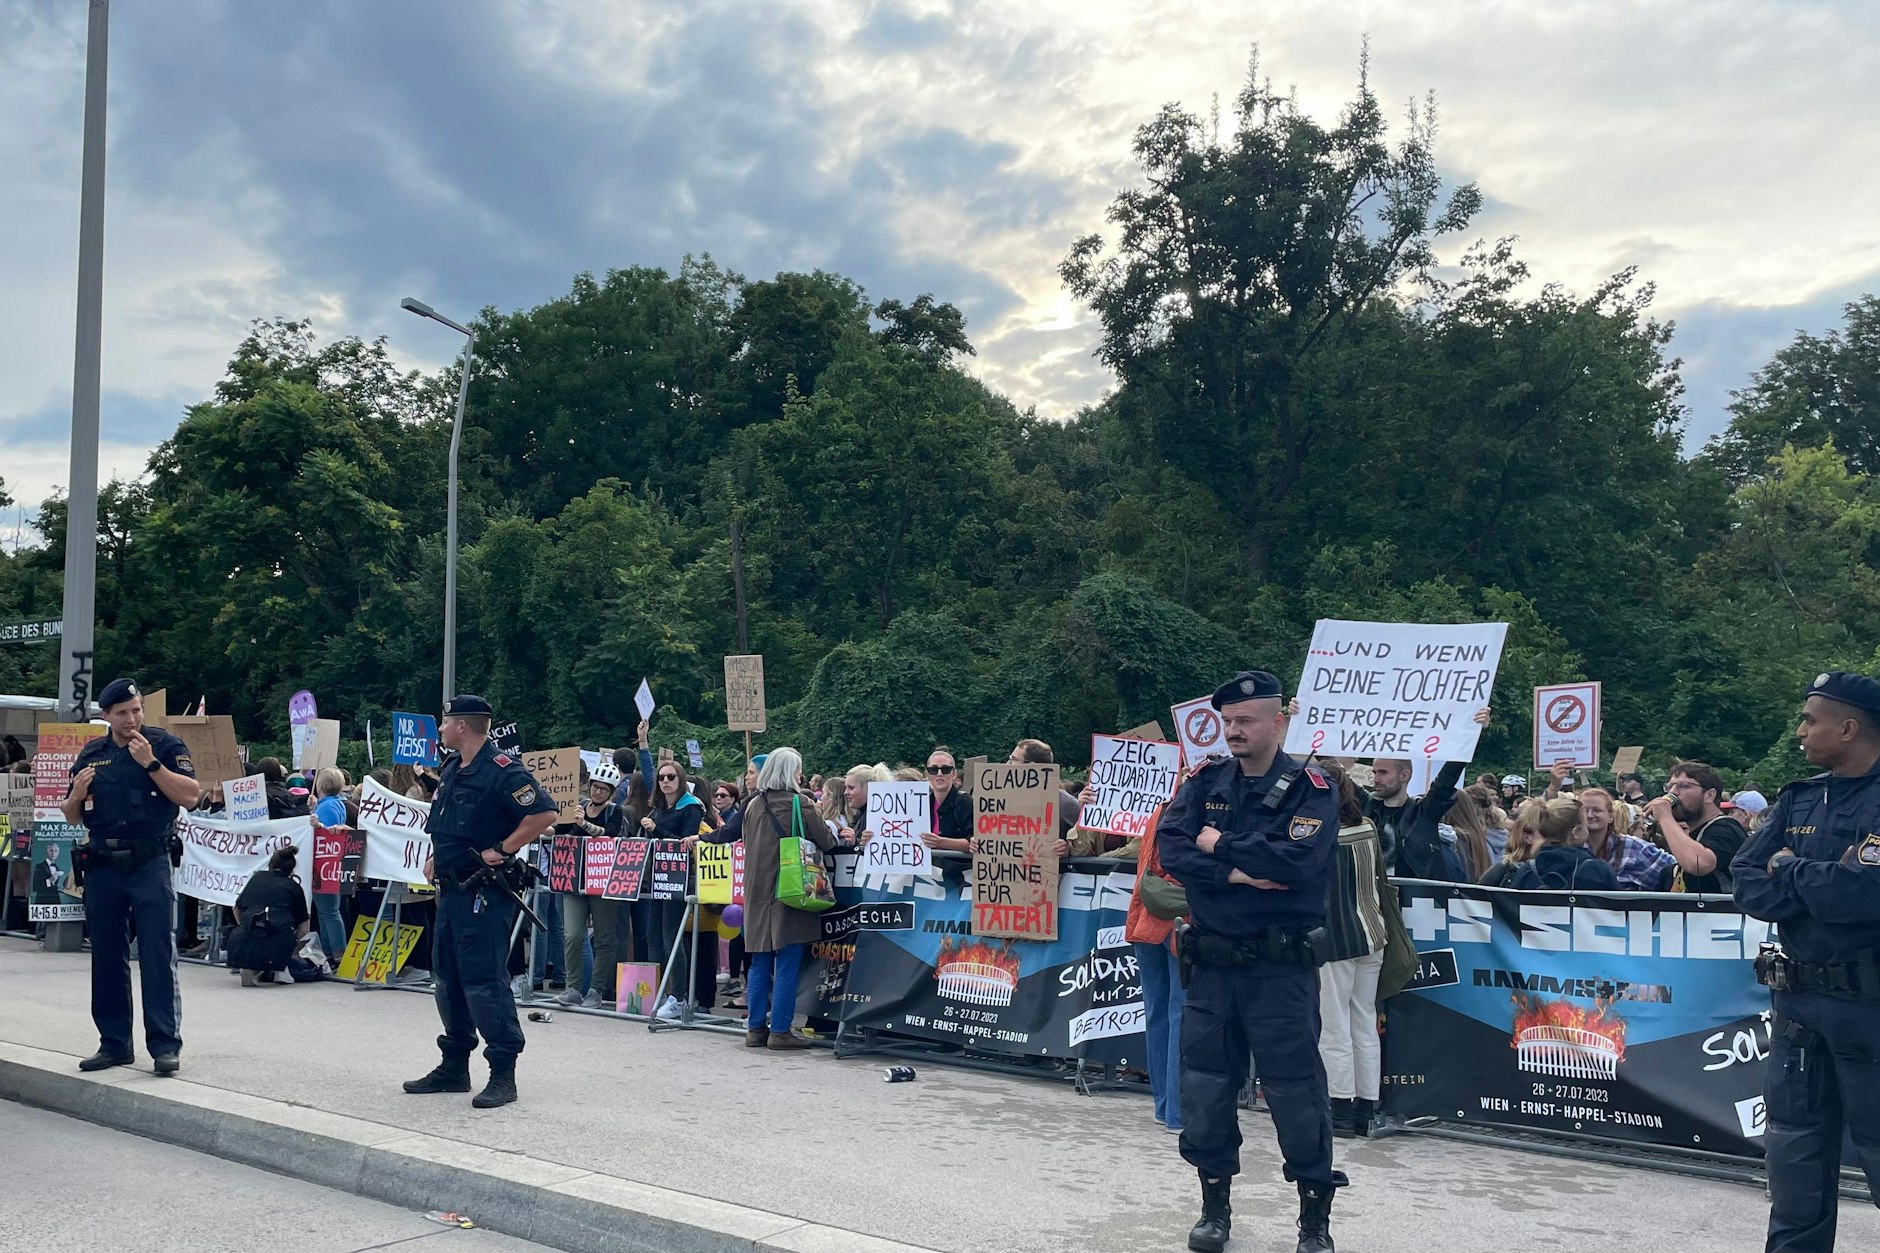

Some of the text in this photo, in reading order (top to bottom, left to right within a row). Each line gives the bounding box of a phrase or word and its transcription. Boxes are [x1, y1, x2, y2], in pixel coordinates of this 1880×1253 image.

[22, 623, 39, 638] DES
[1415, 644, 1488, 663] WENN
[1313, 667, 1491, 703] DEINE TOCHTER
[398, 717, 416, 737] NUR
[1306, 706, 1453, 731] BETROFFEN
[396, 735, 427, 758] HEISST
[1341, 729, 1414, 753] WÄRE
[1111, 738, 1157, 766] ZEIG
[526, 754, 559, 773] SEX
[232, 779, 258, 794] GEGEN
[541, 771, 574, 784] without
[981, 767, 1054, 791] GLAUBT
[1090, 759, 1178, 795] SOLIDARITÄT
[871, 789, 928, 817] DON'T
[979, 796, 1006, 813] DEN
[1084, 807, 1114, 829] VON
[880, 817, 914, 839] GET
[315, 836, 341, 855] END
[588, 841, 614, 852] GOOD
[619, 841, 649, 852] FUCK
[699, 845, 729, 861] KILL
[869, 841, 924, 867] RAPED
[978, 839, 1024, 858] KEINE
[588, 854, 615, 864] NIGHT
[616, 852, 645, 867] OFF
[655, 853, 688, 862] GEWALT
[611, 868, 641, 882] FUCK
[654, 873, 669, 881] WIR
[699, 864, 728, 880] TILL
[977, 857, 1042, 884] BÜHNE
[603, 880, 638, 896] OFF
[653, 882, 684, 892] KRIEGEN
[653, 891, 672, 900] EUCH
[977, 881, 1012, 905] FÜR
[350, 943, 361, 958] I
[1092, 983, 1125, 1003] MIT
[1472, 968, 1673, 1004] RAMMSTEIN
[943, 1005, 954, 1017] 26
[960, 1008, 999, 1024] 27.07.2023
[905, 1014, 1029, 1044] WIEN ERNST-HAPPEL-STADION
[1382, 1074, 1425, 1085] STEIN
[1532, 1082, 1545, 1096] 26
[1555, 1084, 1609, 1103] 27.07.2023
[1480, 1096, 1663, 1129] WIEN ERNST-HAPPEL-STADION
